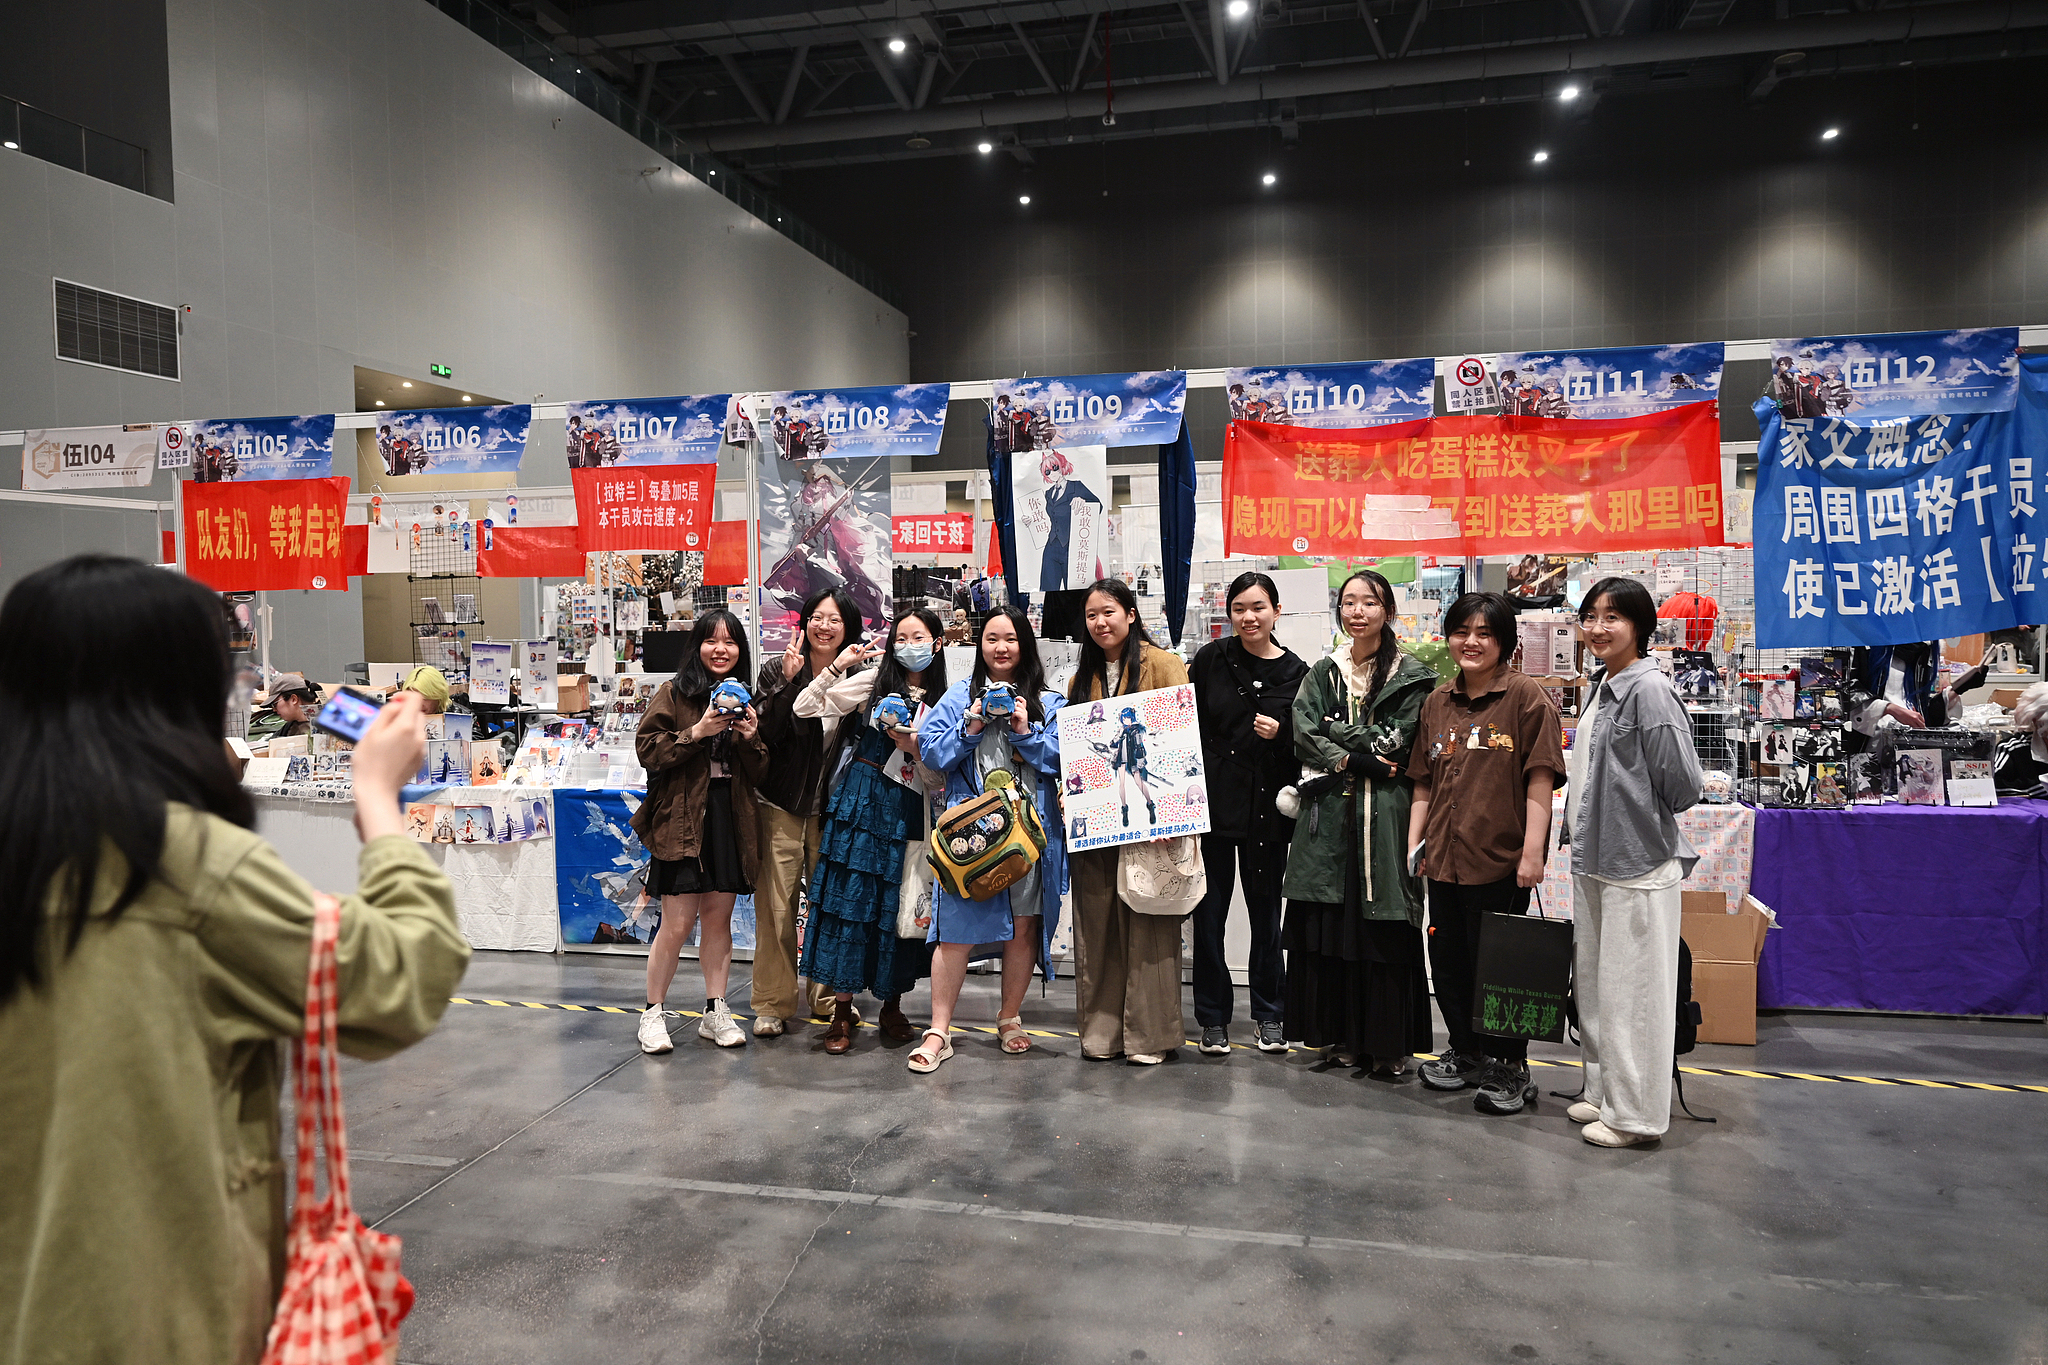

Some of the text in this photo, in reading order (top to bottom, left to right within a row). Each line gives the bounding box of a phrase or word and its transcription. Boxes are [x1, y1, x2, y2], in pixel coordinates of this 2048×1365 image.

[1450, 386, 1495, 400] 同人区域
[1451, 395, 1496, 408] 禁止拍摄
[1294, 431, 1640, 482] 送葬人吃蛋糕没叉子了
[596, 481, 699, 505] 【拉特兰】每叠加5层
[1233, 483, 1719, 539] 隐现可以到送葬人那里吗
[1781, 456, 2048, 545] 周围四格干员
[1027, 497, 1049, 534] 你敢吗
[1781, 532, 2048, 620] 使已激活【拉
[1482, 983, 1507, 993] Fiddling
[1508, 987, 1525, 995] While
[1525, 988, 1543, 997] Texas
